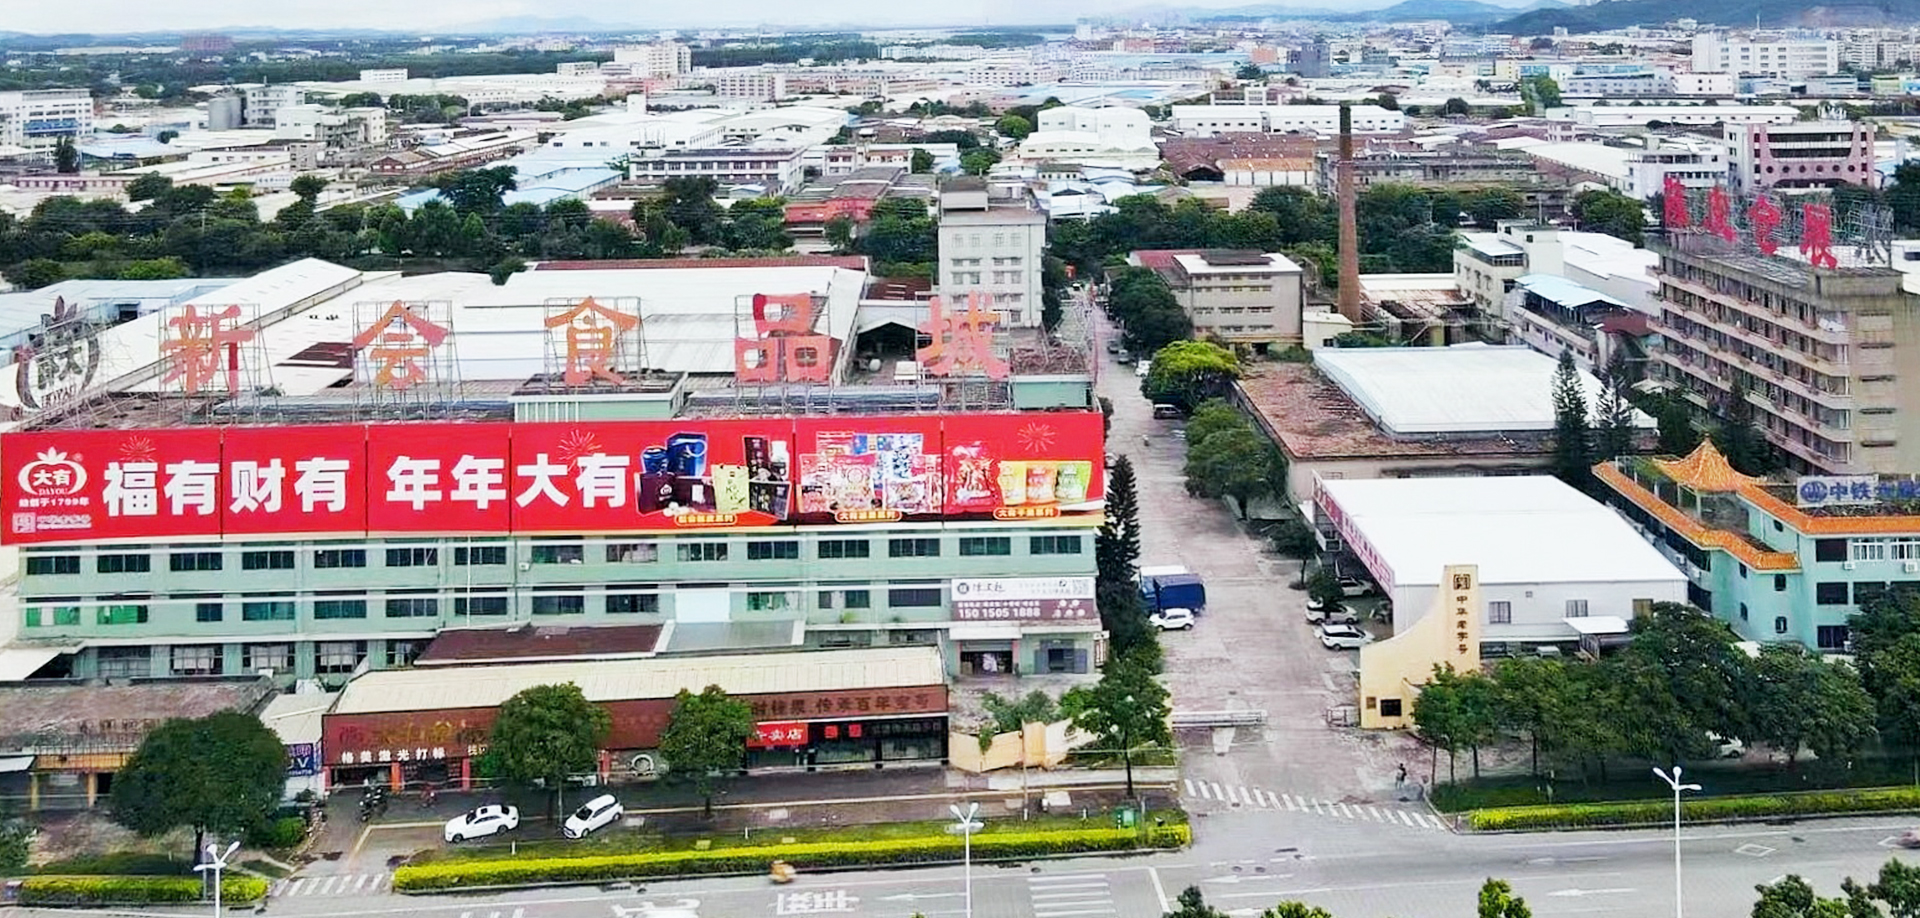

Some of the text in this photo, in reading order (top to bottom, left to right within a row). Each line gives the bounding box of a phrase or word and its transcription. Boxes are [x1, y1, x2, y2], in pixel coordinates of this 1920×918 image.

[33, 469, 71, 486] 大有
[103, 453, 630, 516] 福有财有 年年大有
[959, 609, 980, 619] 150
[982, 608, 1010, 618] 1505
